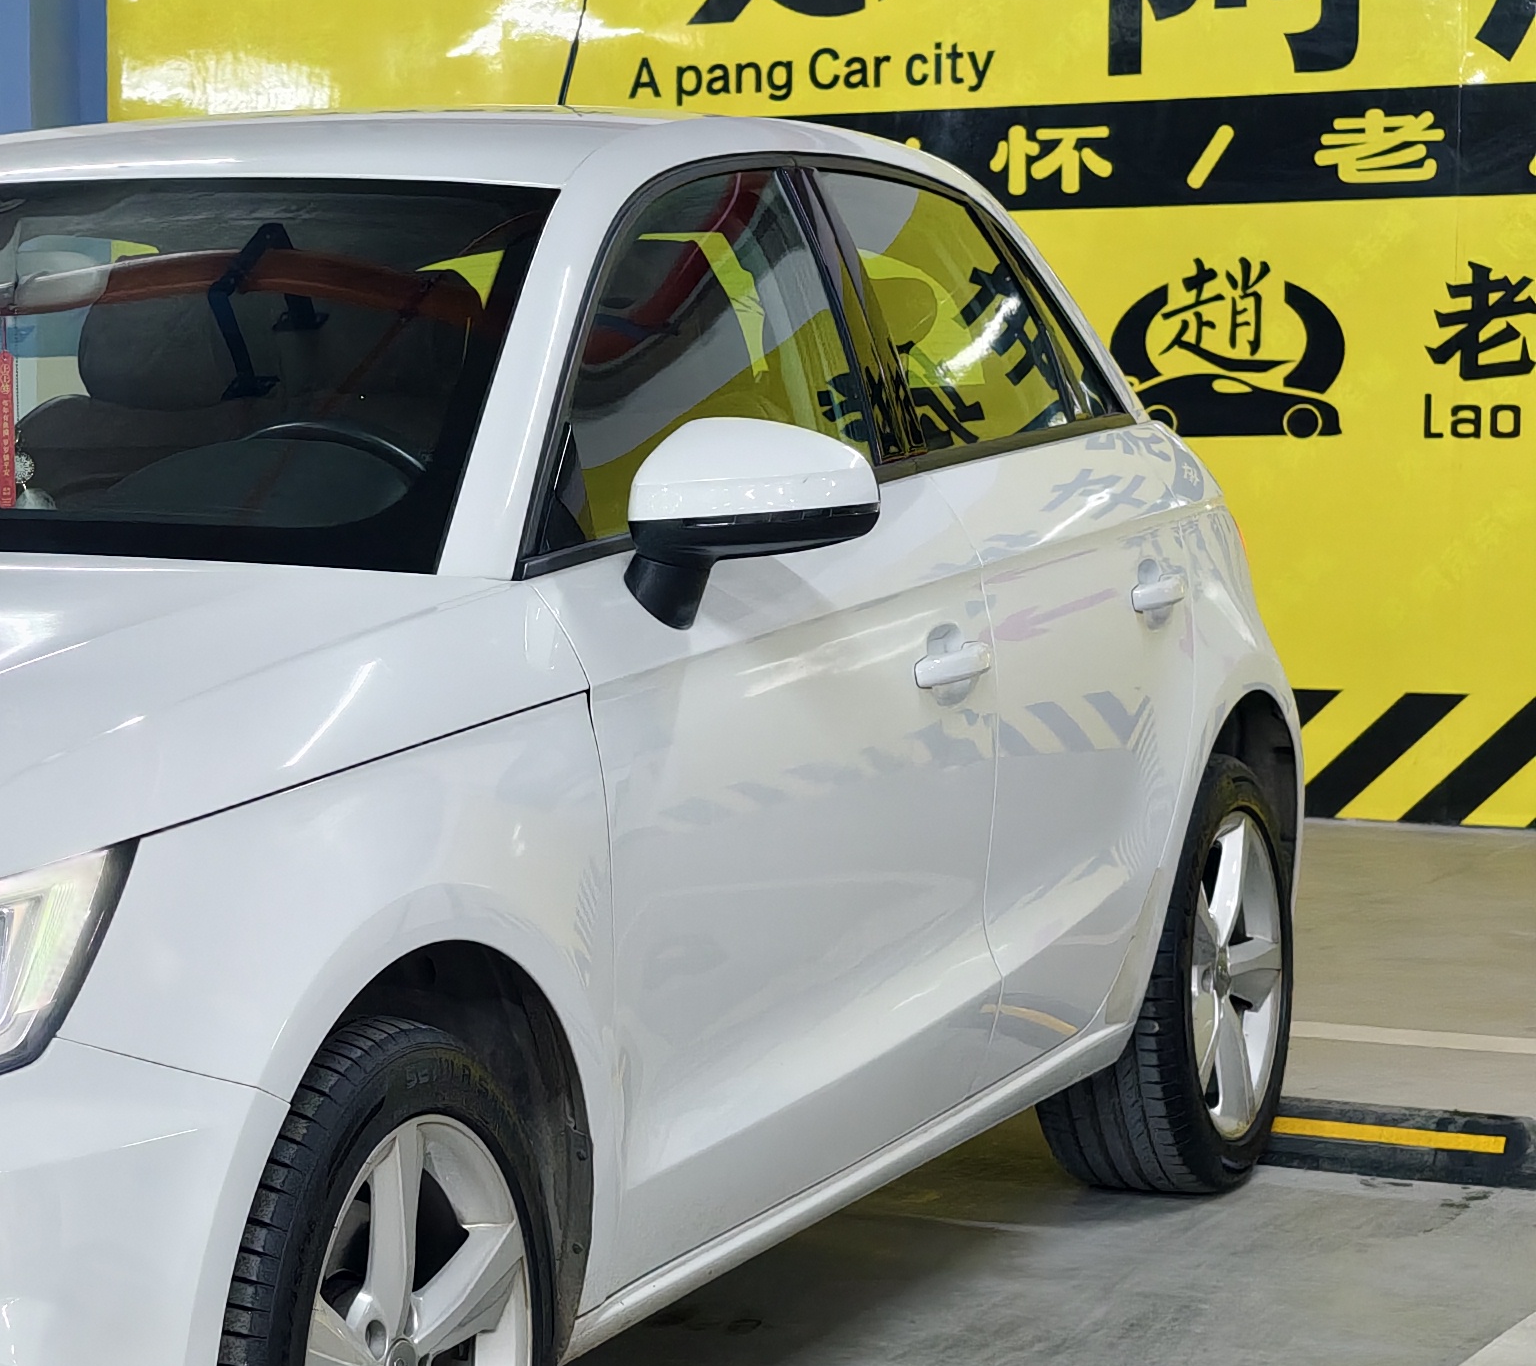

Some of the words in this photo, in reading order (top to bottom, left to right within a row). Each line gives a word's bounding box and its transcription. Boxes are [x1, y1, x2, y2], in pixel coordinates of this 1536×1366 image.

[629, 57, 661, 99] A
[676, 60, 794, 106] pang
[809, 47, 891, 90] Car
[905, 41, 995, 92] city
[1424, 393, 1521, 439] Lao
